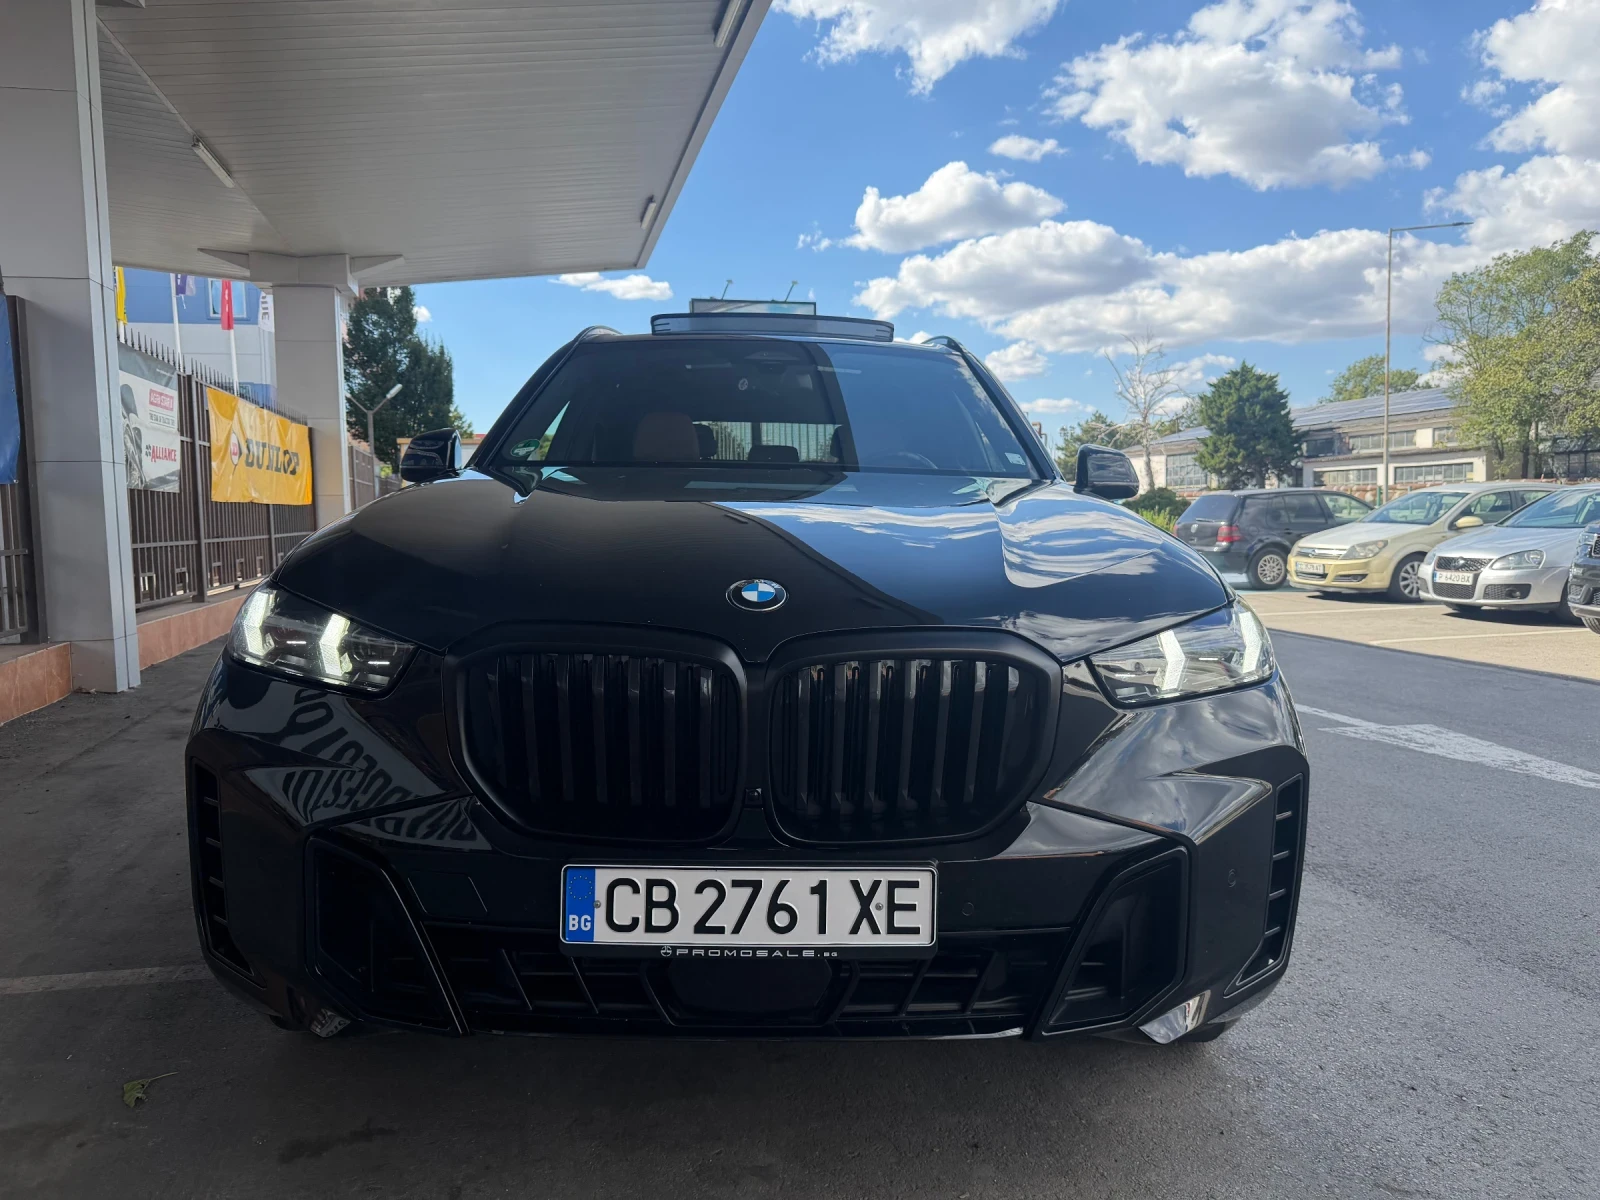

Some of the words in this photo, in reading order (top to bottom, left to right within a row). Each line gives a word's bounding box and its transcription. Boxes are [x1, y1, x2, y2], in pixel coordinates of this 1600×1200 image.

[151, 445, 177, 462] ALLIANCE
[245, 438, 300, 476] DUNLOP
[606, 877, 679, 933] CB
[694, 878, 829, 936] 2761
[848, 879, 921, 936] XE
[568, 914, 592, 932] BG
